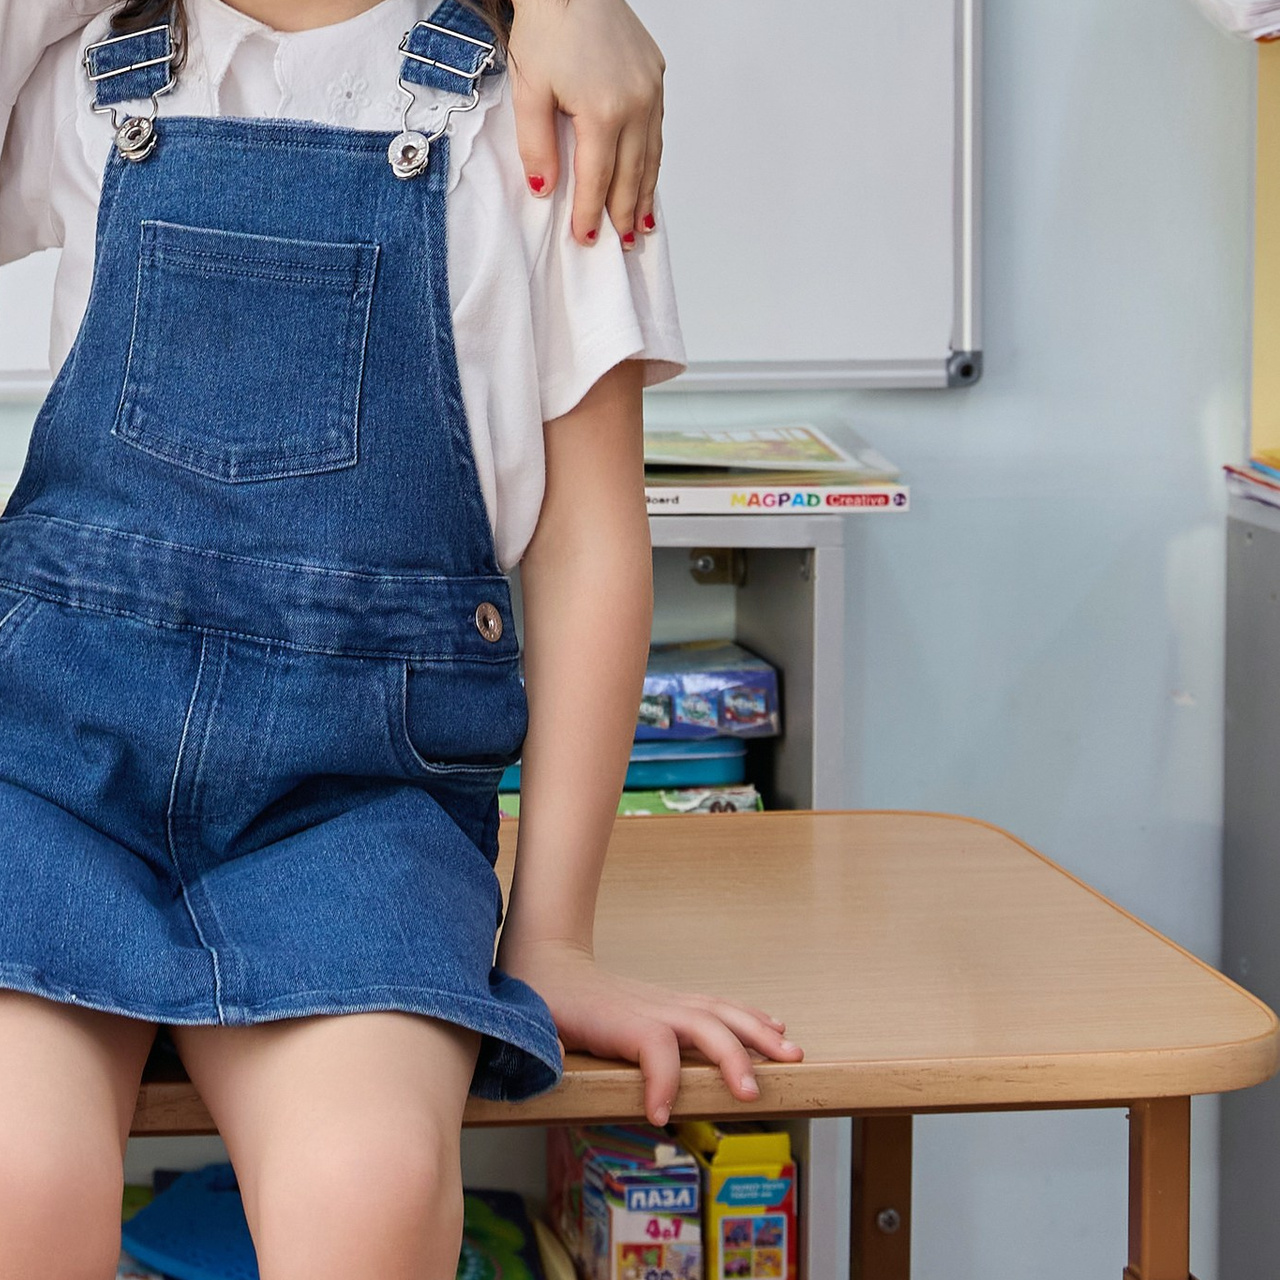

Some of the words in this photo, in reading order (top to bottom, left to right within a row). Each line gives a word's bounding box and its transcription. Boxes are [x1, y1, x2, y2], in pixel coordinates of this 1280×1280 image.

[731, 493, 821, 507] MAGPAD
[830, 494, 887, 506] Creative
[630, 1188, 691, 1209] ПАЗЛ
